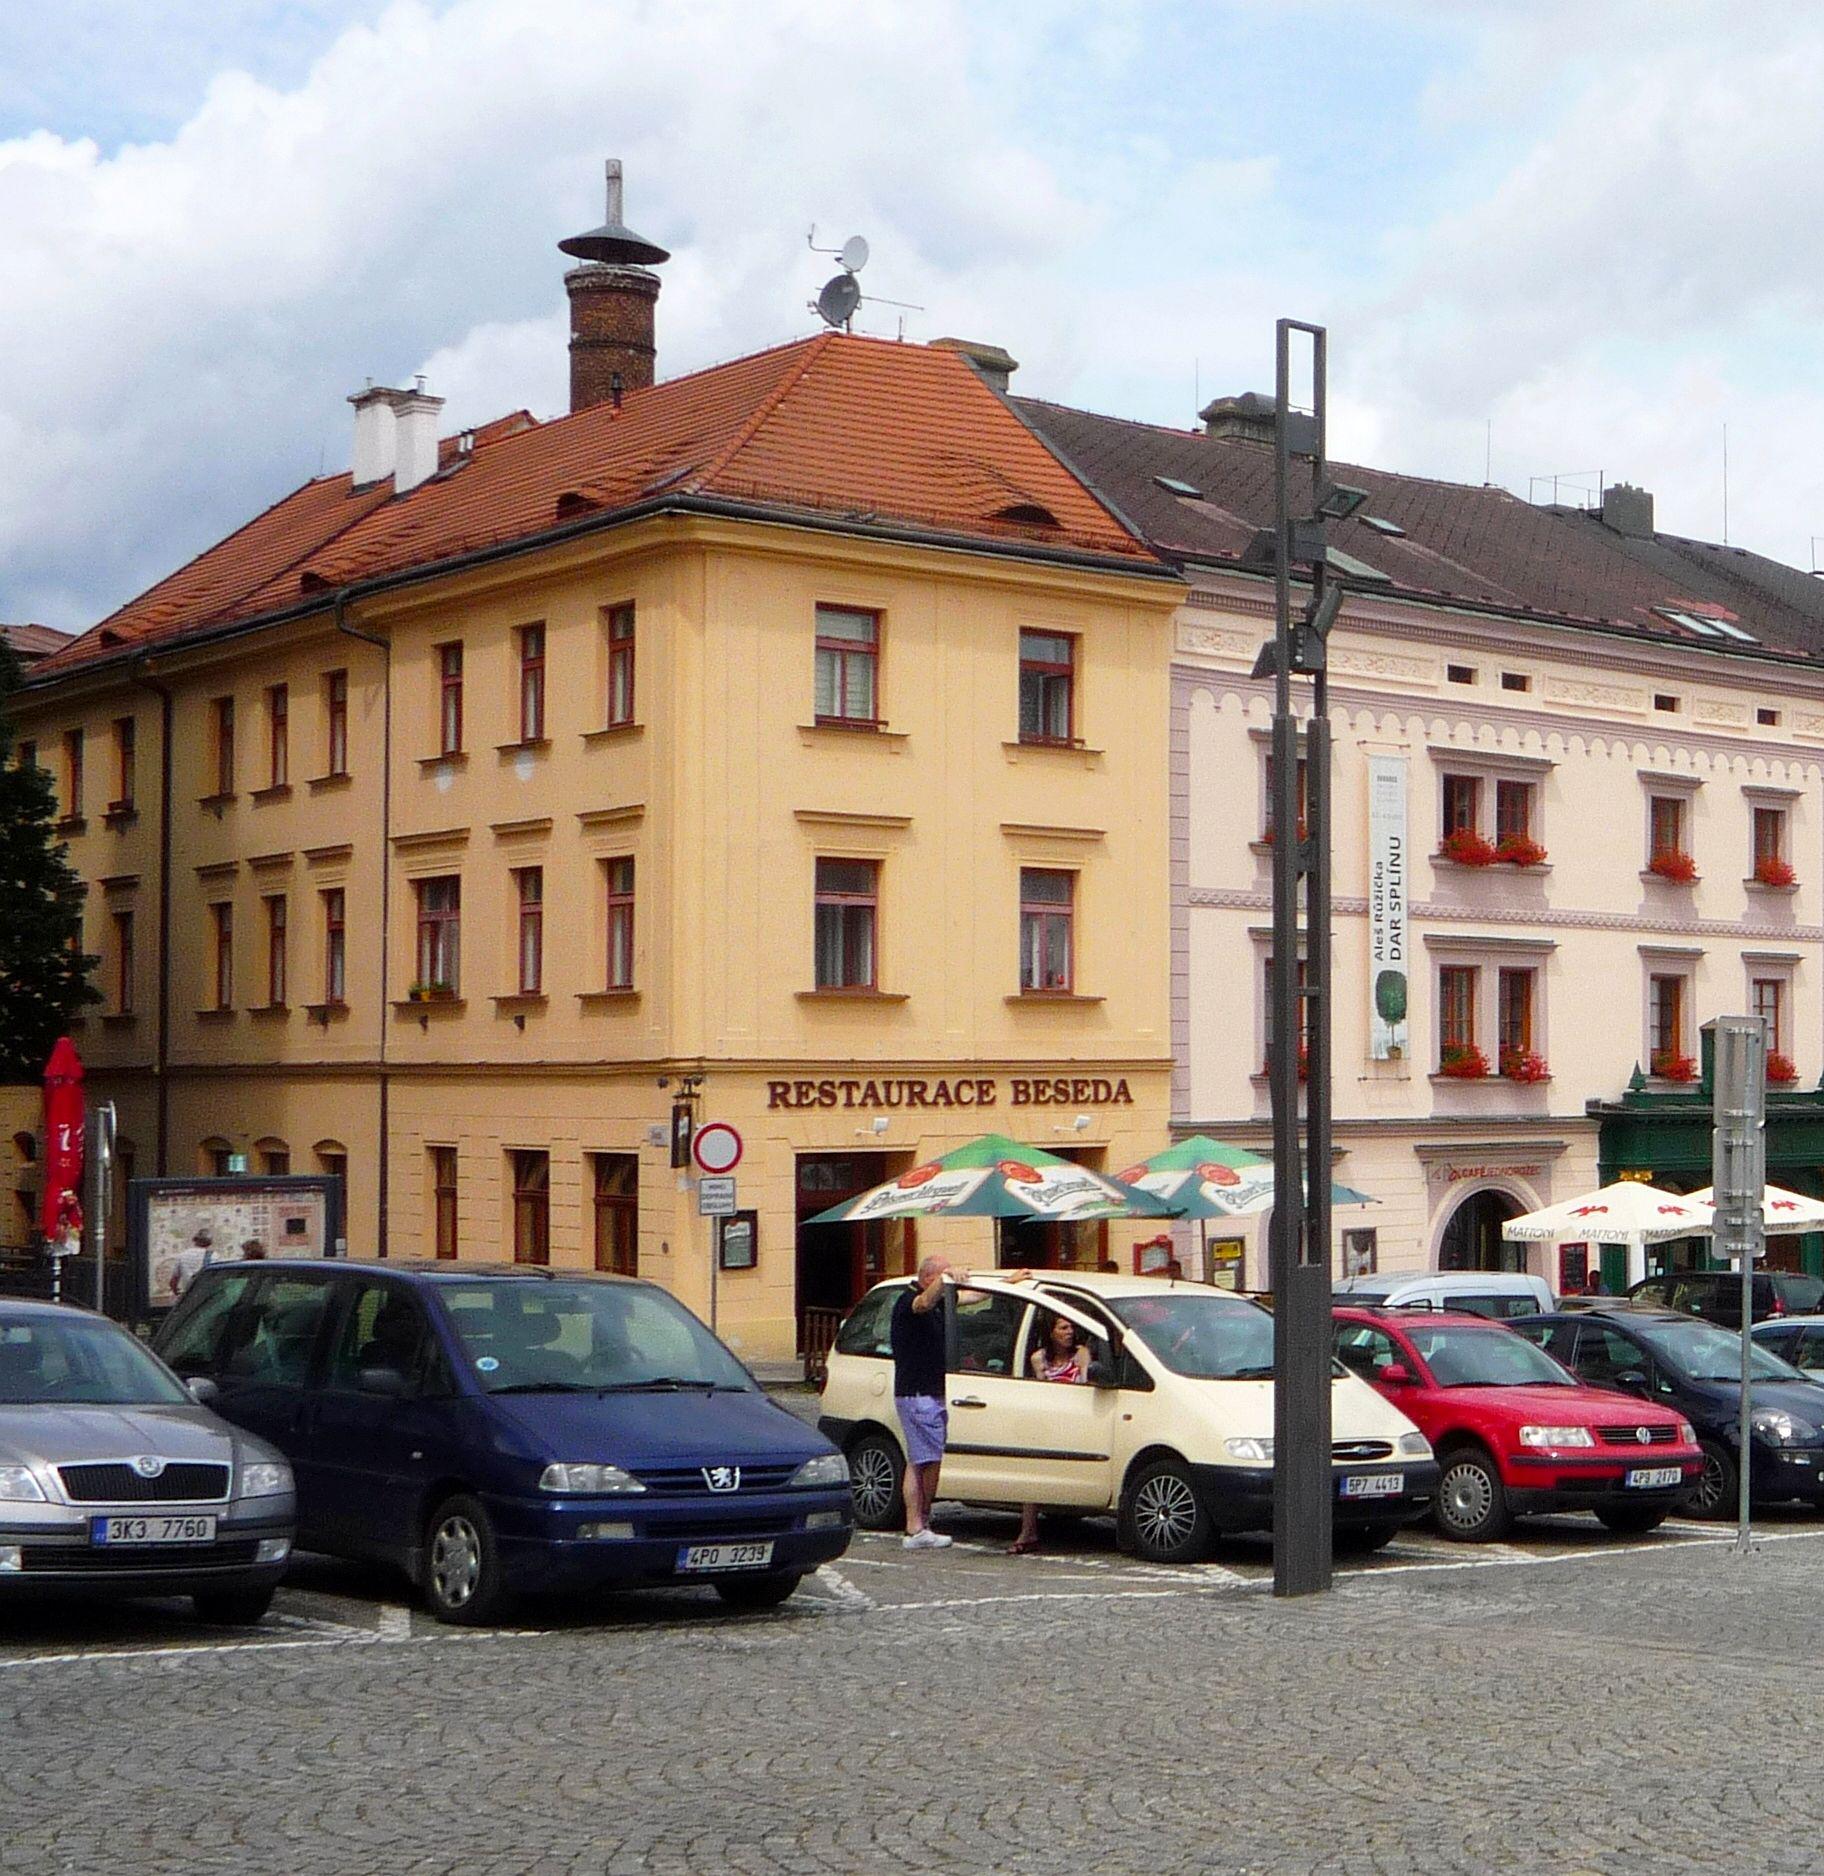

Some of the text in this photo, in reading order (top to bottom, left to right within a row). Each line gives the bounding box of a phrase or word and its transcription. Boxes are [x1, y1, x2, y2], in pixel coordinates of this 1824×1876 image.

[1386, 836, 1402, 961] DAR SPLÍNU
[1373, 927, 1384, 961] Aleš
[767, 1078, 1134, 1108] RESTAURACE BESEDA
[111, 1520, 147, 1540] 3K3
[162, 1519, 208, 1538] 7760
[730, 1545, 766, 1563] 3239
